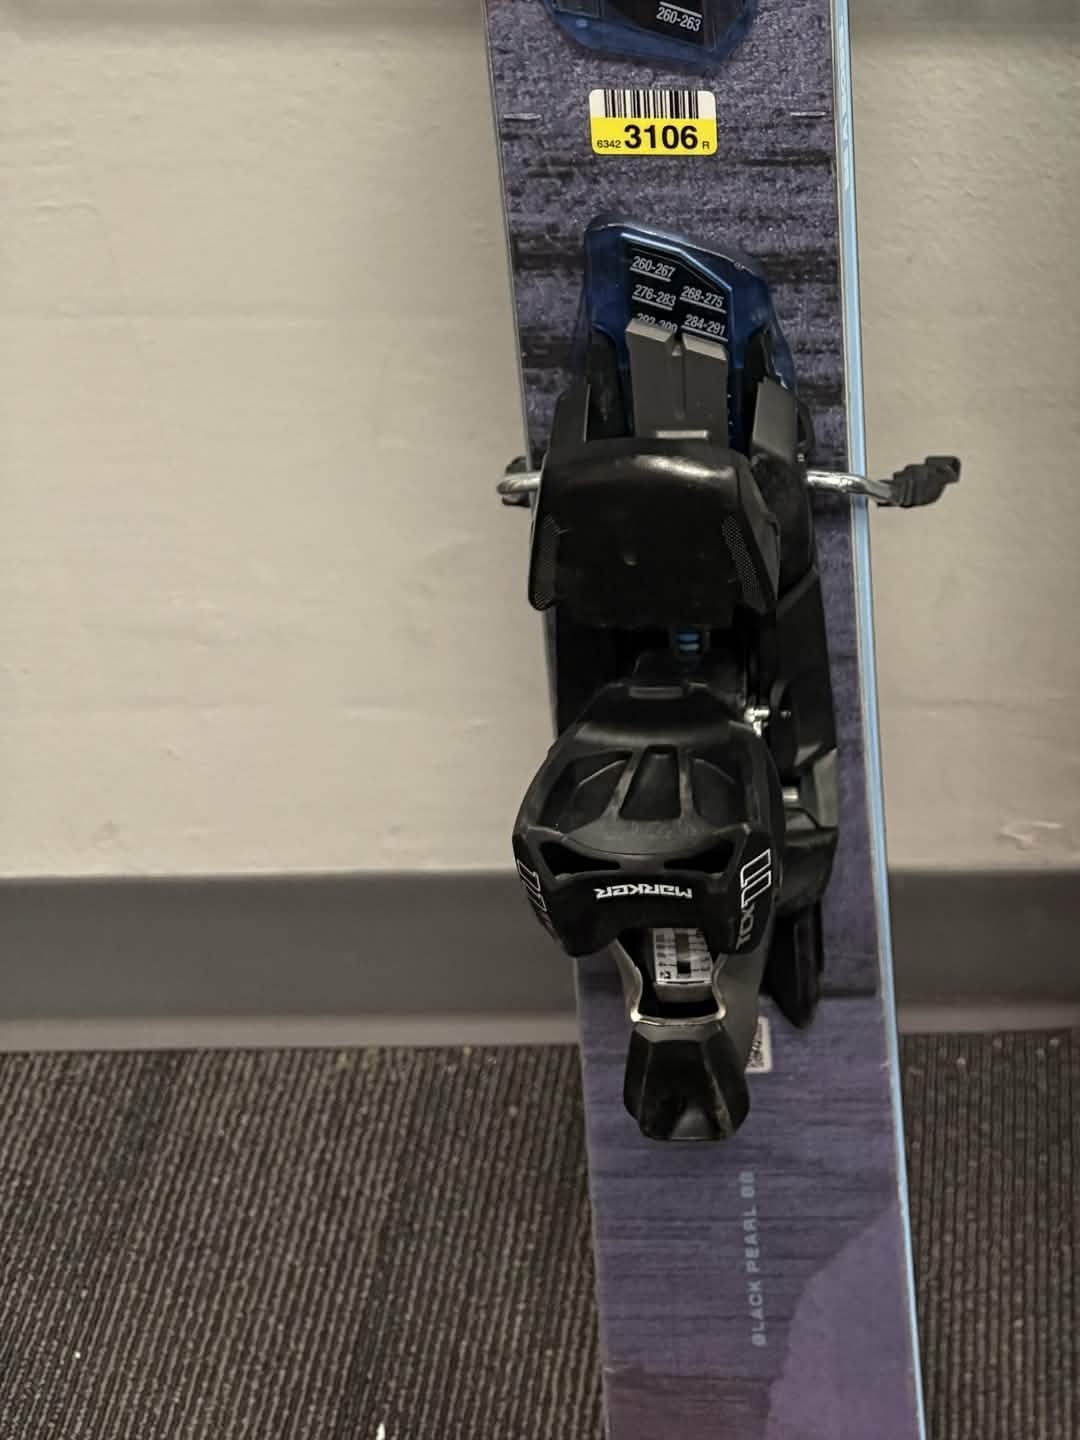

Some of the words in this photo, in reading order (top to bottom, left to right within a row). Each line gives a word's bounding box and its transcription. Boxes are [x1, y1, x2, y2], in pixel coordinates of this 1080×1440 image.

[656, 7, 701, 32] 260-263
[596, 140, 621, 148] 6342
[624, 124, 698, 150] 3106
[702, 141, 710, 150] R
[632, 256, 676, 278] 260-267
[633, 285, 677, 307] 276-283
[681, 286, 725, 308] 268-275
[684, 314, 725, 335] 284-291
[593, 883, 692, 900] MARKER
[743, 1206, 759, 1273] PEARL
[749, 1280, 766, 1347] BLACK
